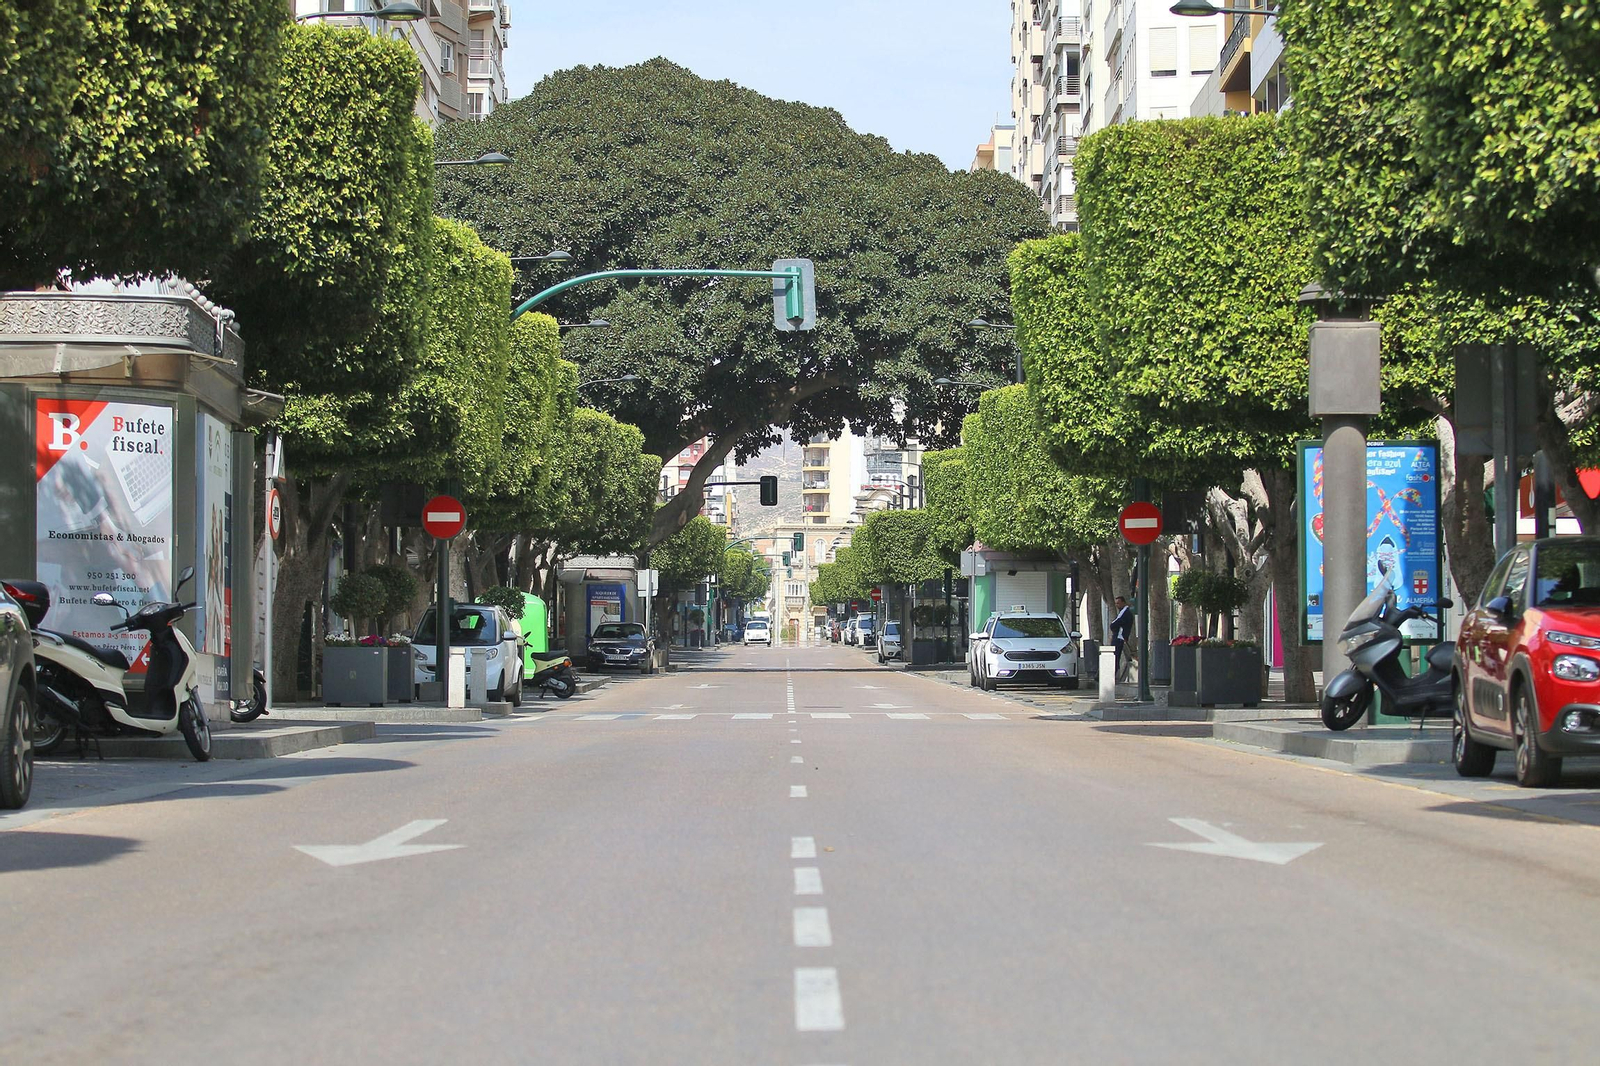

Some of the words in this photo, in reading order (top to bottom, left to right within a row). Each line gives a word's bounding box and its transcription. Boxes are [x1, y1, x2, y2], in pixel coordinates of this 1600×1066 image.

[112, 416, 165, 435] Bufete
[112, 436, 163, 455] fiscal.
[1384, 459, 1401, 468] azul
[48, 530, 114, 541] Economistas
[116, 533, 124, 541] &
[126, 533, 165, 544] Abogados
[87, 571, 103, 580] 950
[105, 572, 119, 580] 251
[69, 584, 150, 593] www.bufetefiscal.net
[60, 597, 88, 605] Bufete
[72, 630, 105, 639] Estamos
[120, 631, 148, 639] minutos
[102, 643, 119, 651] Pérez
[121, 643, 137, 652] Pérez,
